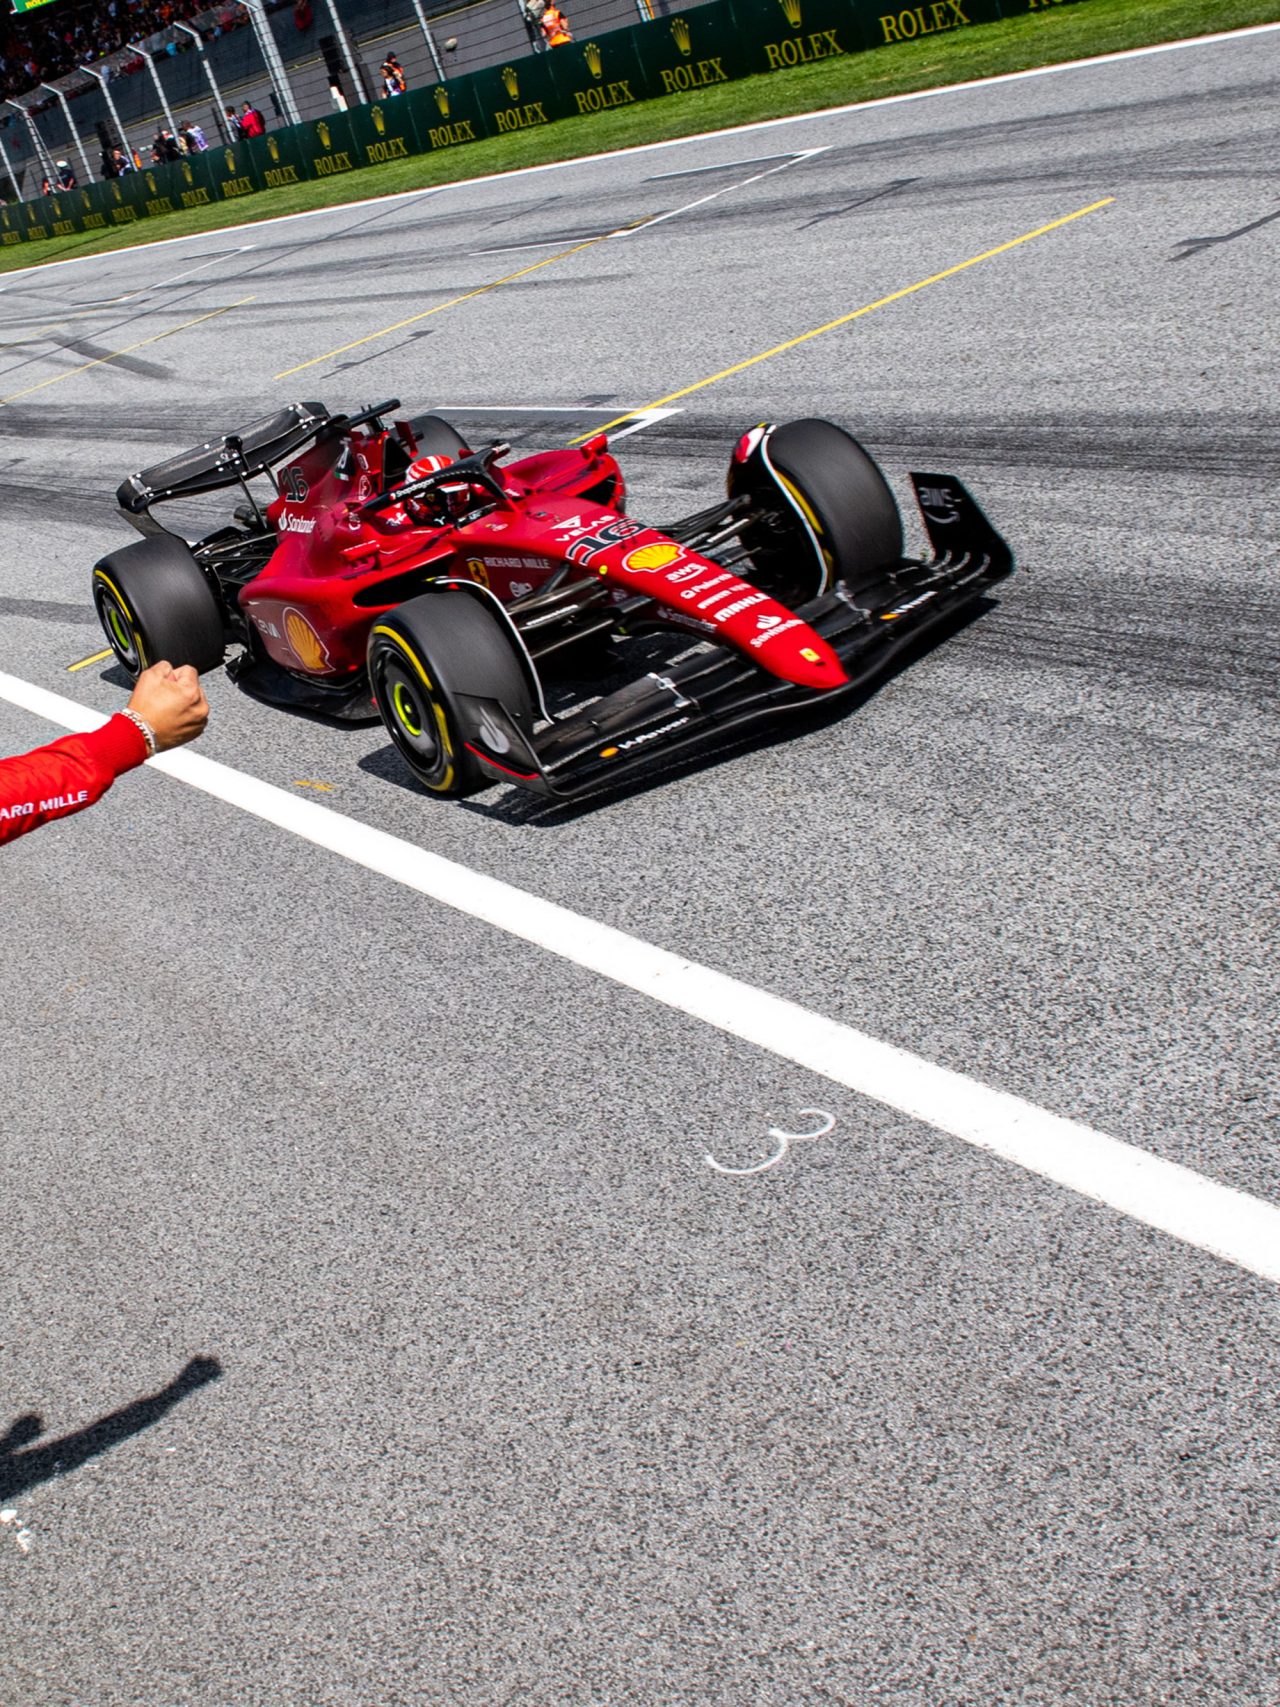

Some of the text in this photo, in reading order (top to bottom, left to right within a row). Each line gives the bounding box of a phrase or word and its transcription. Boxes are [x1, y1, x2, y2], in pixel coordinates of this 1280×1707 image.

[878, 0, 970, 43] ROLEX
[764, 29, 844, 69] ROLEX
[660, 57, 729, 93] ROLEX
[574, 79, 636, 114] ROLEX
[495, 102, 548, 132] ROLEX
[428, 120, 476, 148] ROLEX
[366, 137, 409, 163] ROLEX
[264, 165, 299, 187] ROLEX
[314, 152, 352, 175] ROLEX
[180, 187, 210, 207] ROLEX
[221, 176, 254, 198] ROLEX
[281, 466, 310, 504] 16
[287, 513, 317, 534] Santander
[565, 518, 648, 567] 16
[483, 557, 551, 569] RICHARD MILLE
[665, 562, 703, 581] aws
[39, 790, 88, 812] MILLE
